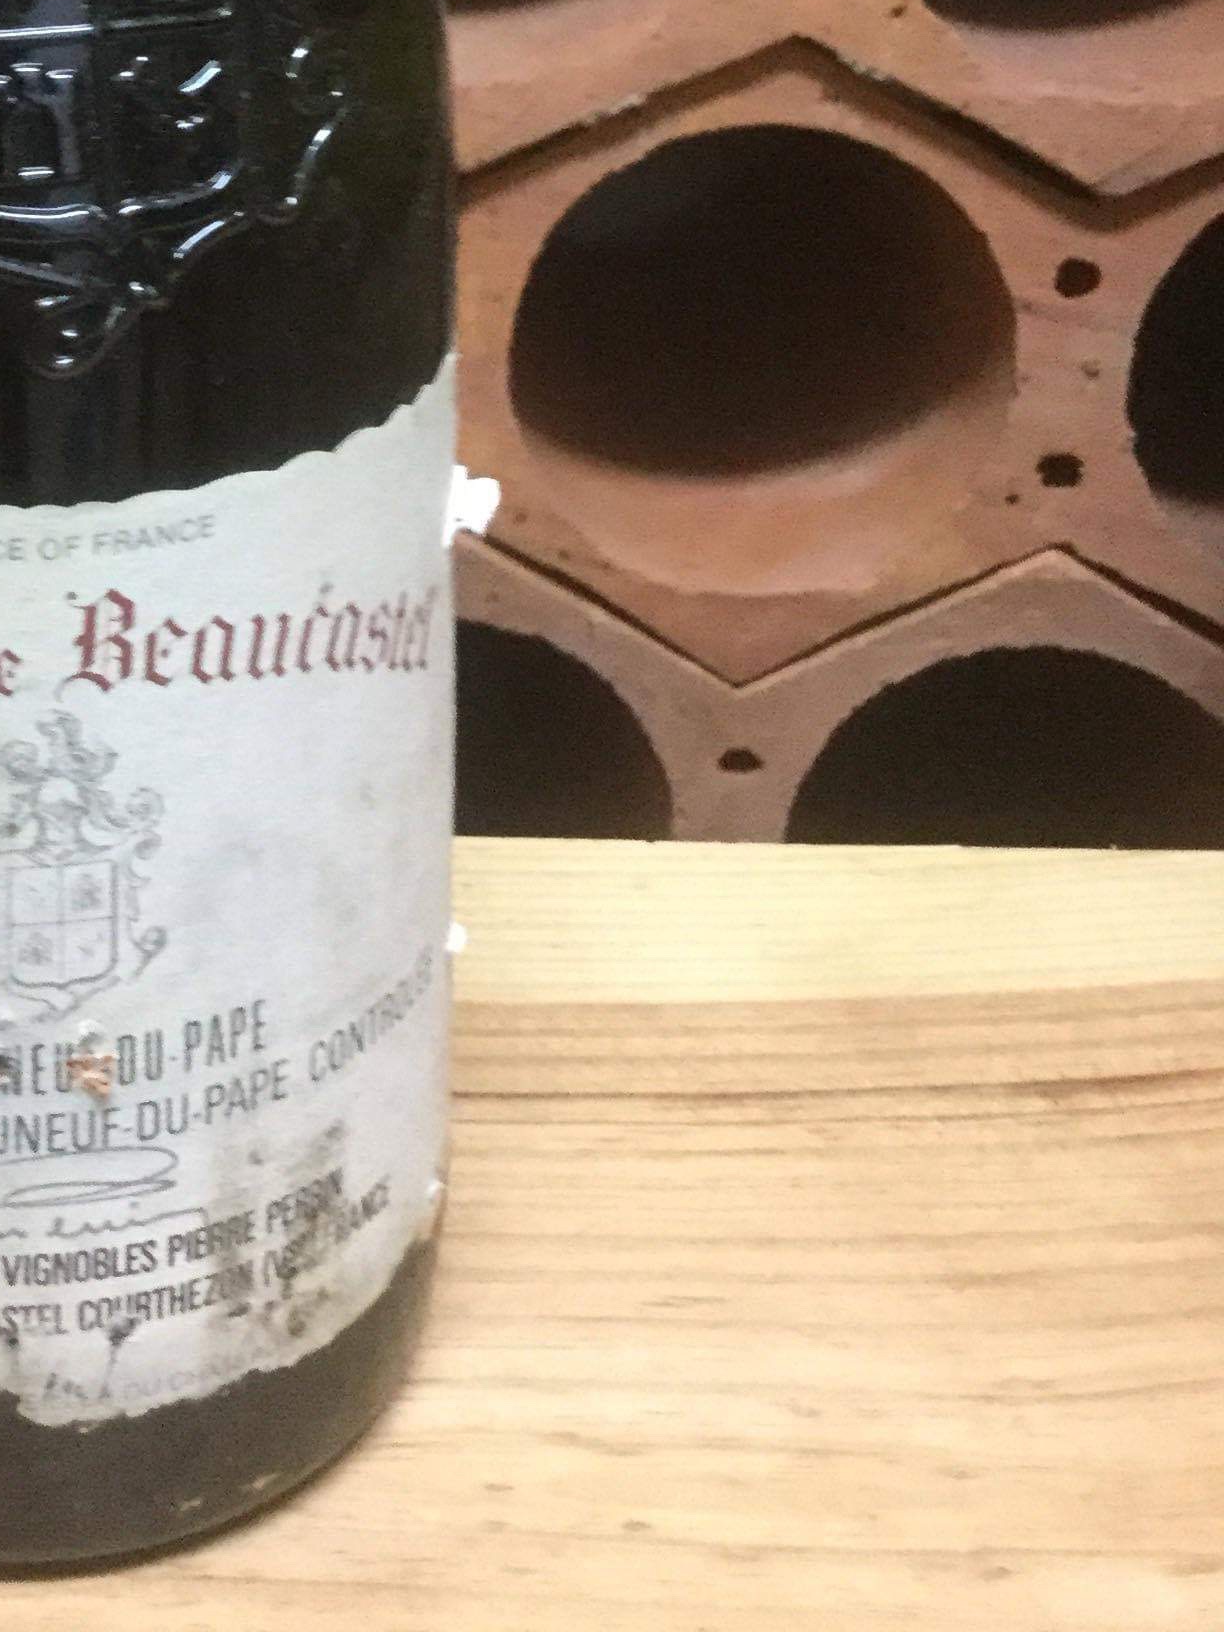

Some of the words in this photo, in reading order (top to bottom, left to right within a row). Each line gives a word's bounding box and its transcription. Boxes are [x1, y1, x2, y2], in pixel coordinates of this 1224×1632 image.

[37, 535, 79, 560] OF
[91, 514, 216, 555] FRANCE
[1, 1240, 159, 1287] VIGNOBLES
